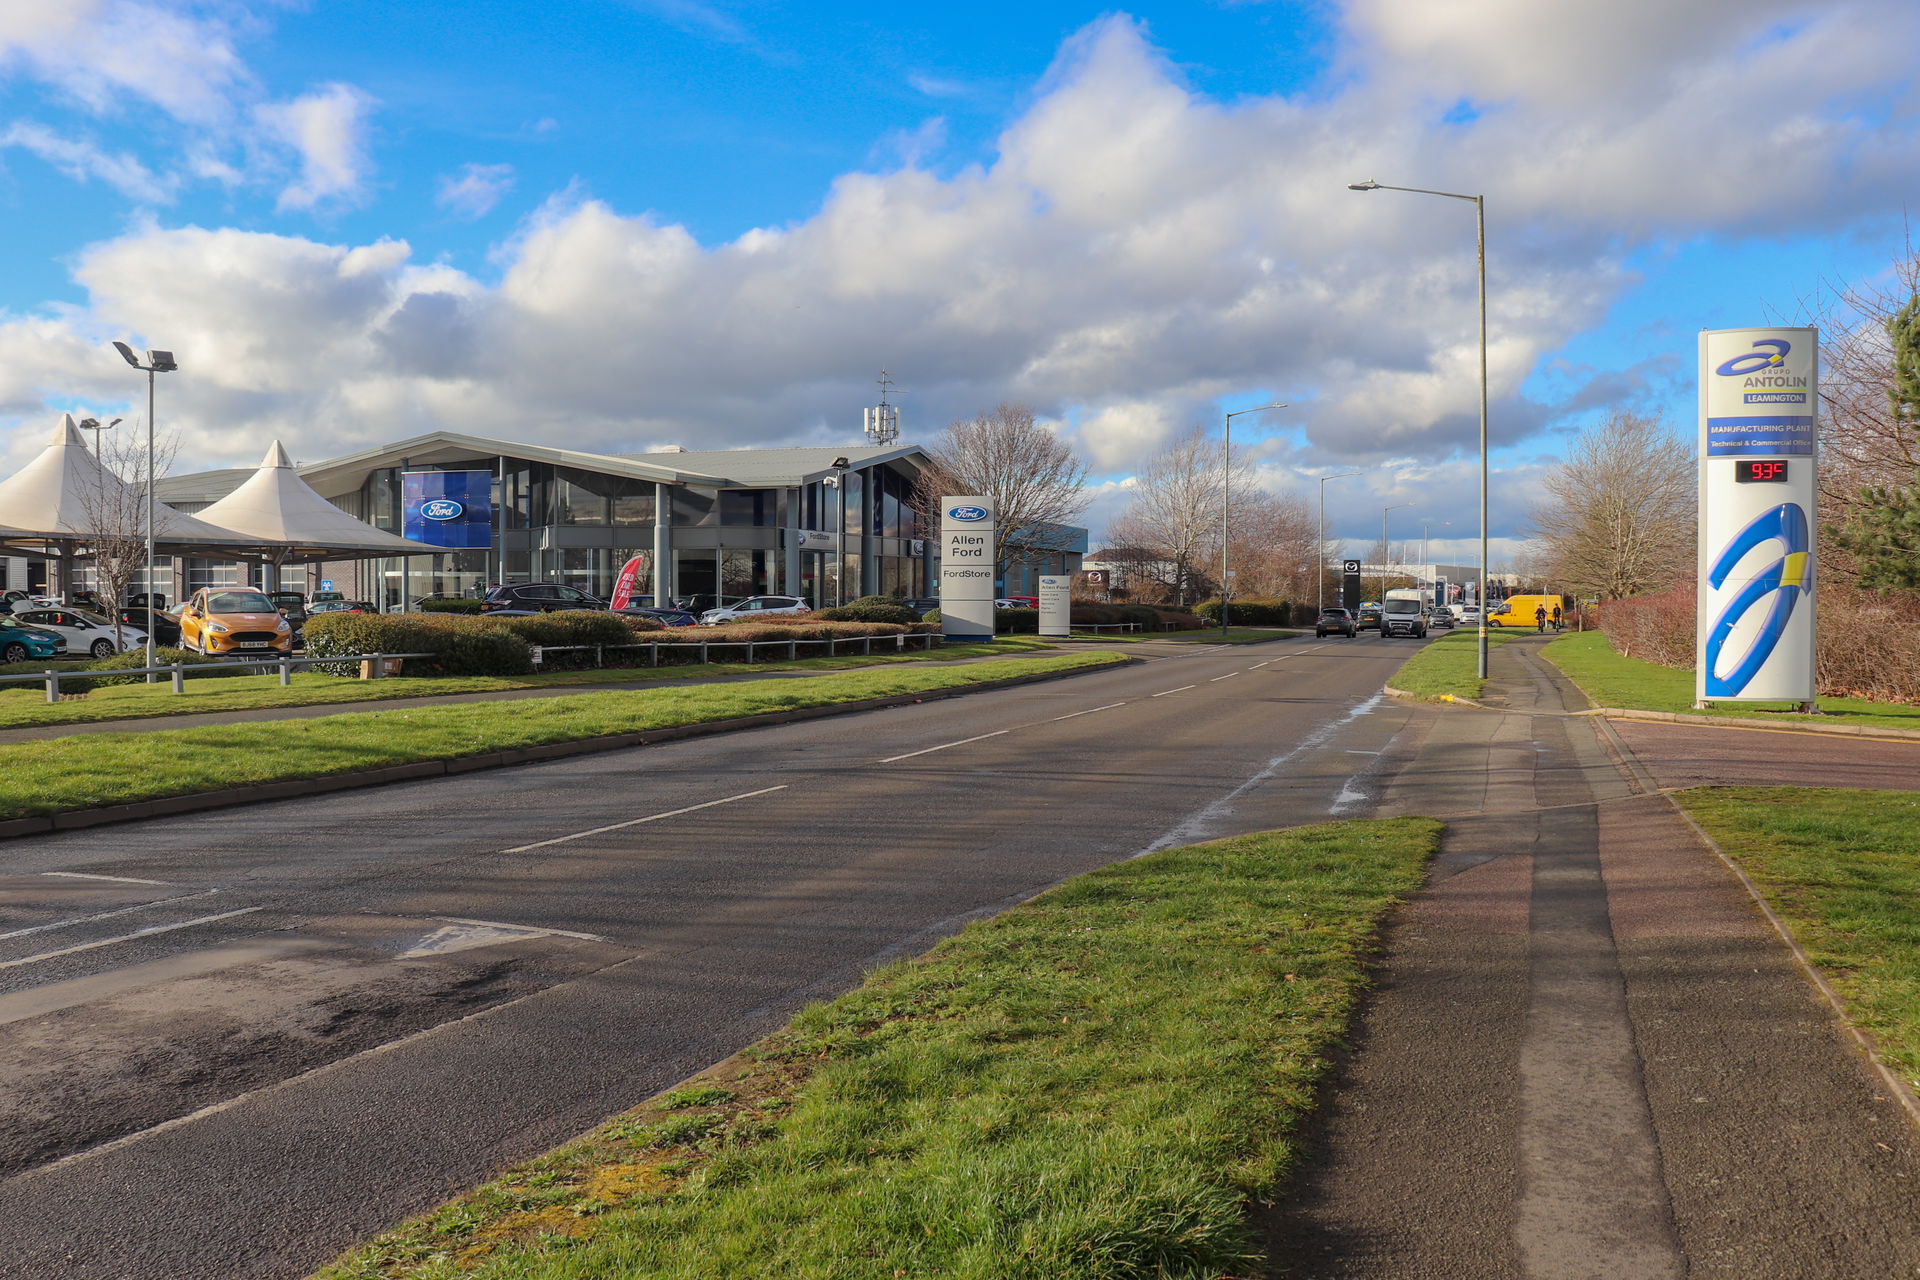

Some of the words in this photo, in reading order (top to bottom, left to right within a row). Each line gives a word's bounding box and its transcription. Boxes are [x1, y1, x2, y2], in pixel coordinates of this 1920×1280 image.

[1744, 376, 1807, 388] ANTOLIN
[1748, 394, 1803, 403] LEAMINGTON
[1711, 425, 1784, 433] MANUFACTURING
[1751, 439, 1792, 447] Commercial
[428, 503, 454, 516] Ford
[956, 508, 979, 518] Ford
[951, 535, 984, 545] Allen
[952, 548, 982, 557] Ford
[943, 570, 991, 578] FordStore
